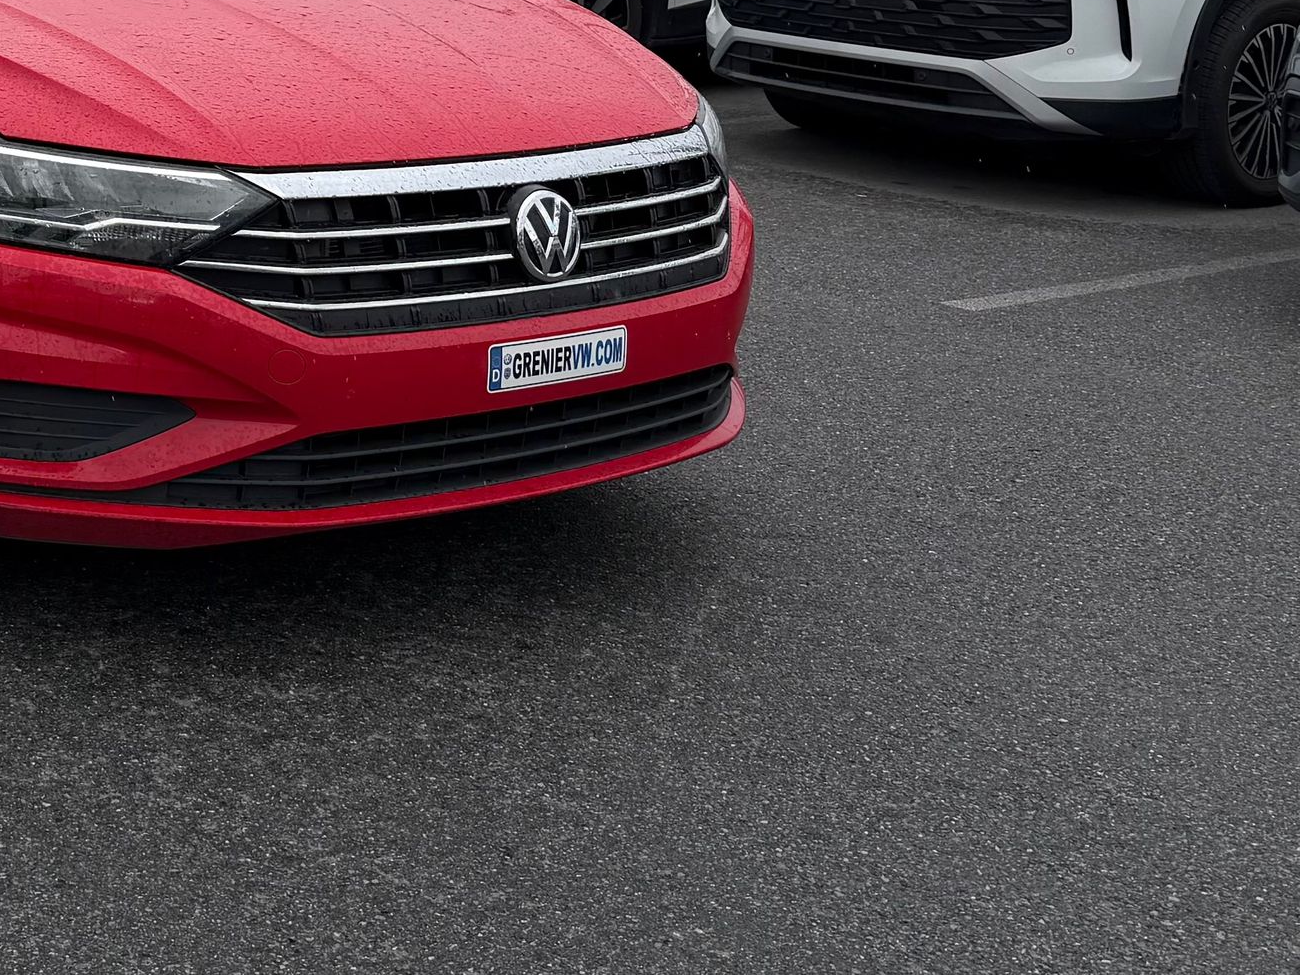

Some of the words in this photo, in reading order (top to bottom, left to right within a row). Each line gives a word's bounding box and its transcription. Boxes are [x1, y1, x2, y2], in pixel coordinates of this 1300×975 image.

[519, 192, 577, 275] VW
[492, 369, 501, 382] D
[512, 337, 623, 379] GRENIERVW.COM
